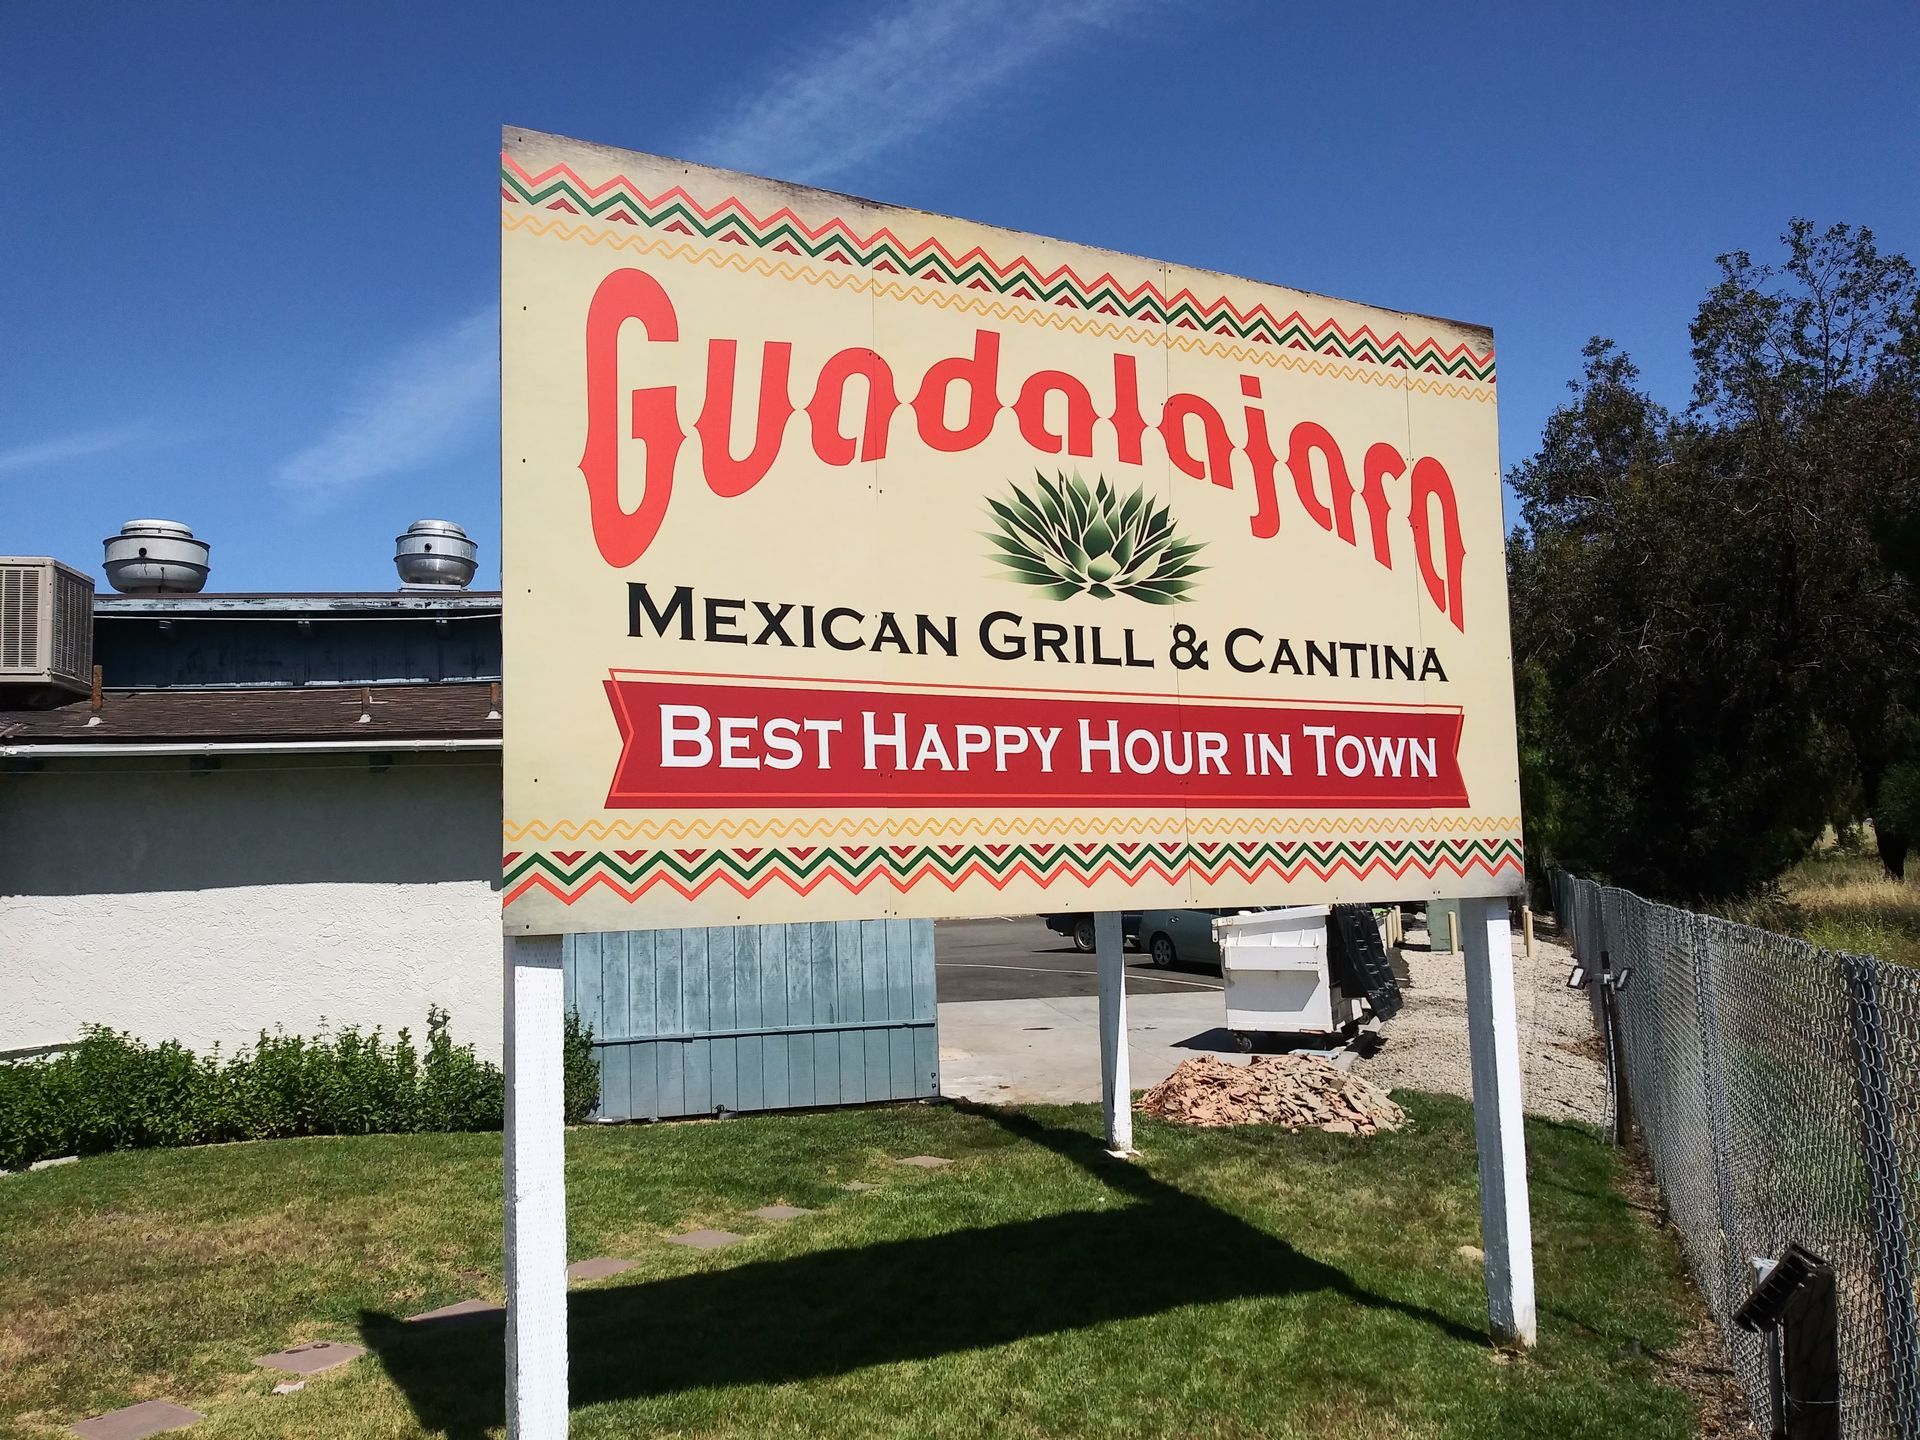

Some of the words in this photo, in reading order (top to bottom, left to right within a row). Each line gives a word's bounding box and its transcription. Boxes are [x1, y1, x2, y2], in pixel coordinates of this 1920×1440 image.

[578, 267, 1467, 633] Guadalajara
[626, 581, 959, 657] MEXICAN
[979, 610, 1155, 669] GRILL
[1169, 622, 1209, 671] &
[1224, 627, 1449, 682] CANTINA
[658, 704, 843, 771] BEST
[861, 711, 1063, 773] HAPPY
[1077, 718, 1232, 775] HOUR
[1243, 733, 1293, 776] IN
[1302, 724, 1438, 778] TOWN
